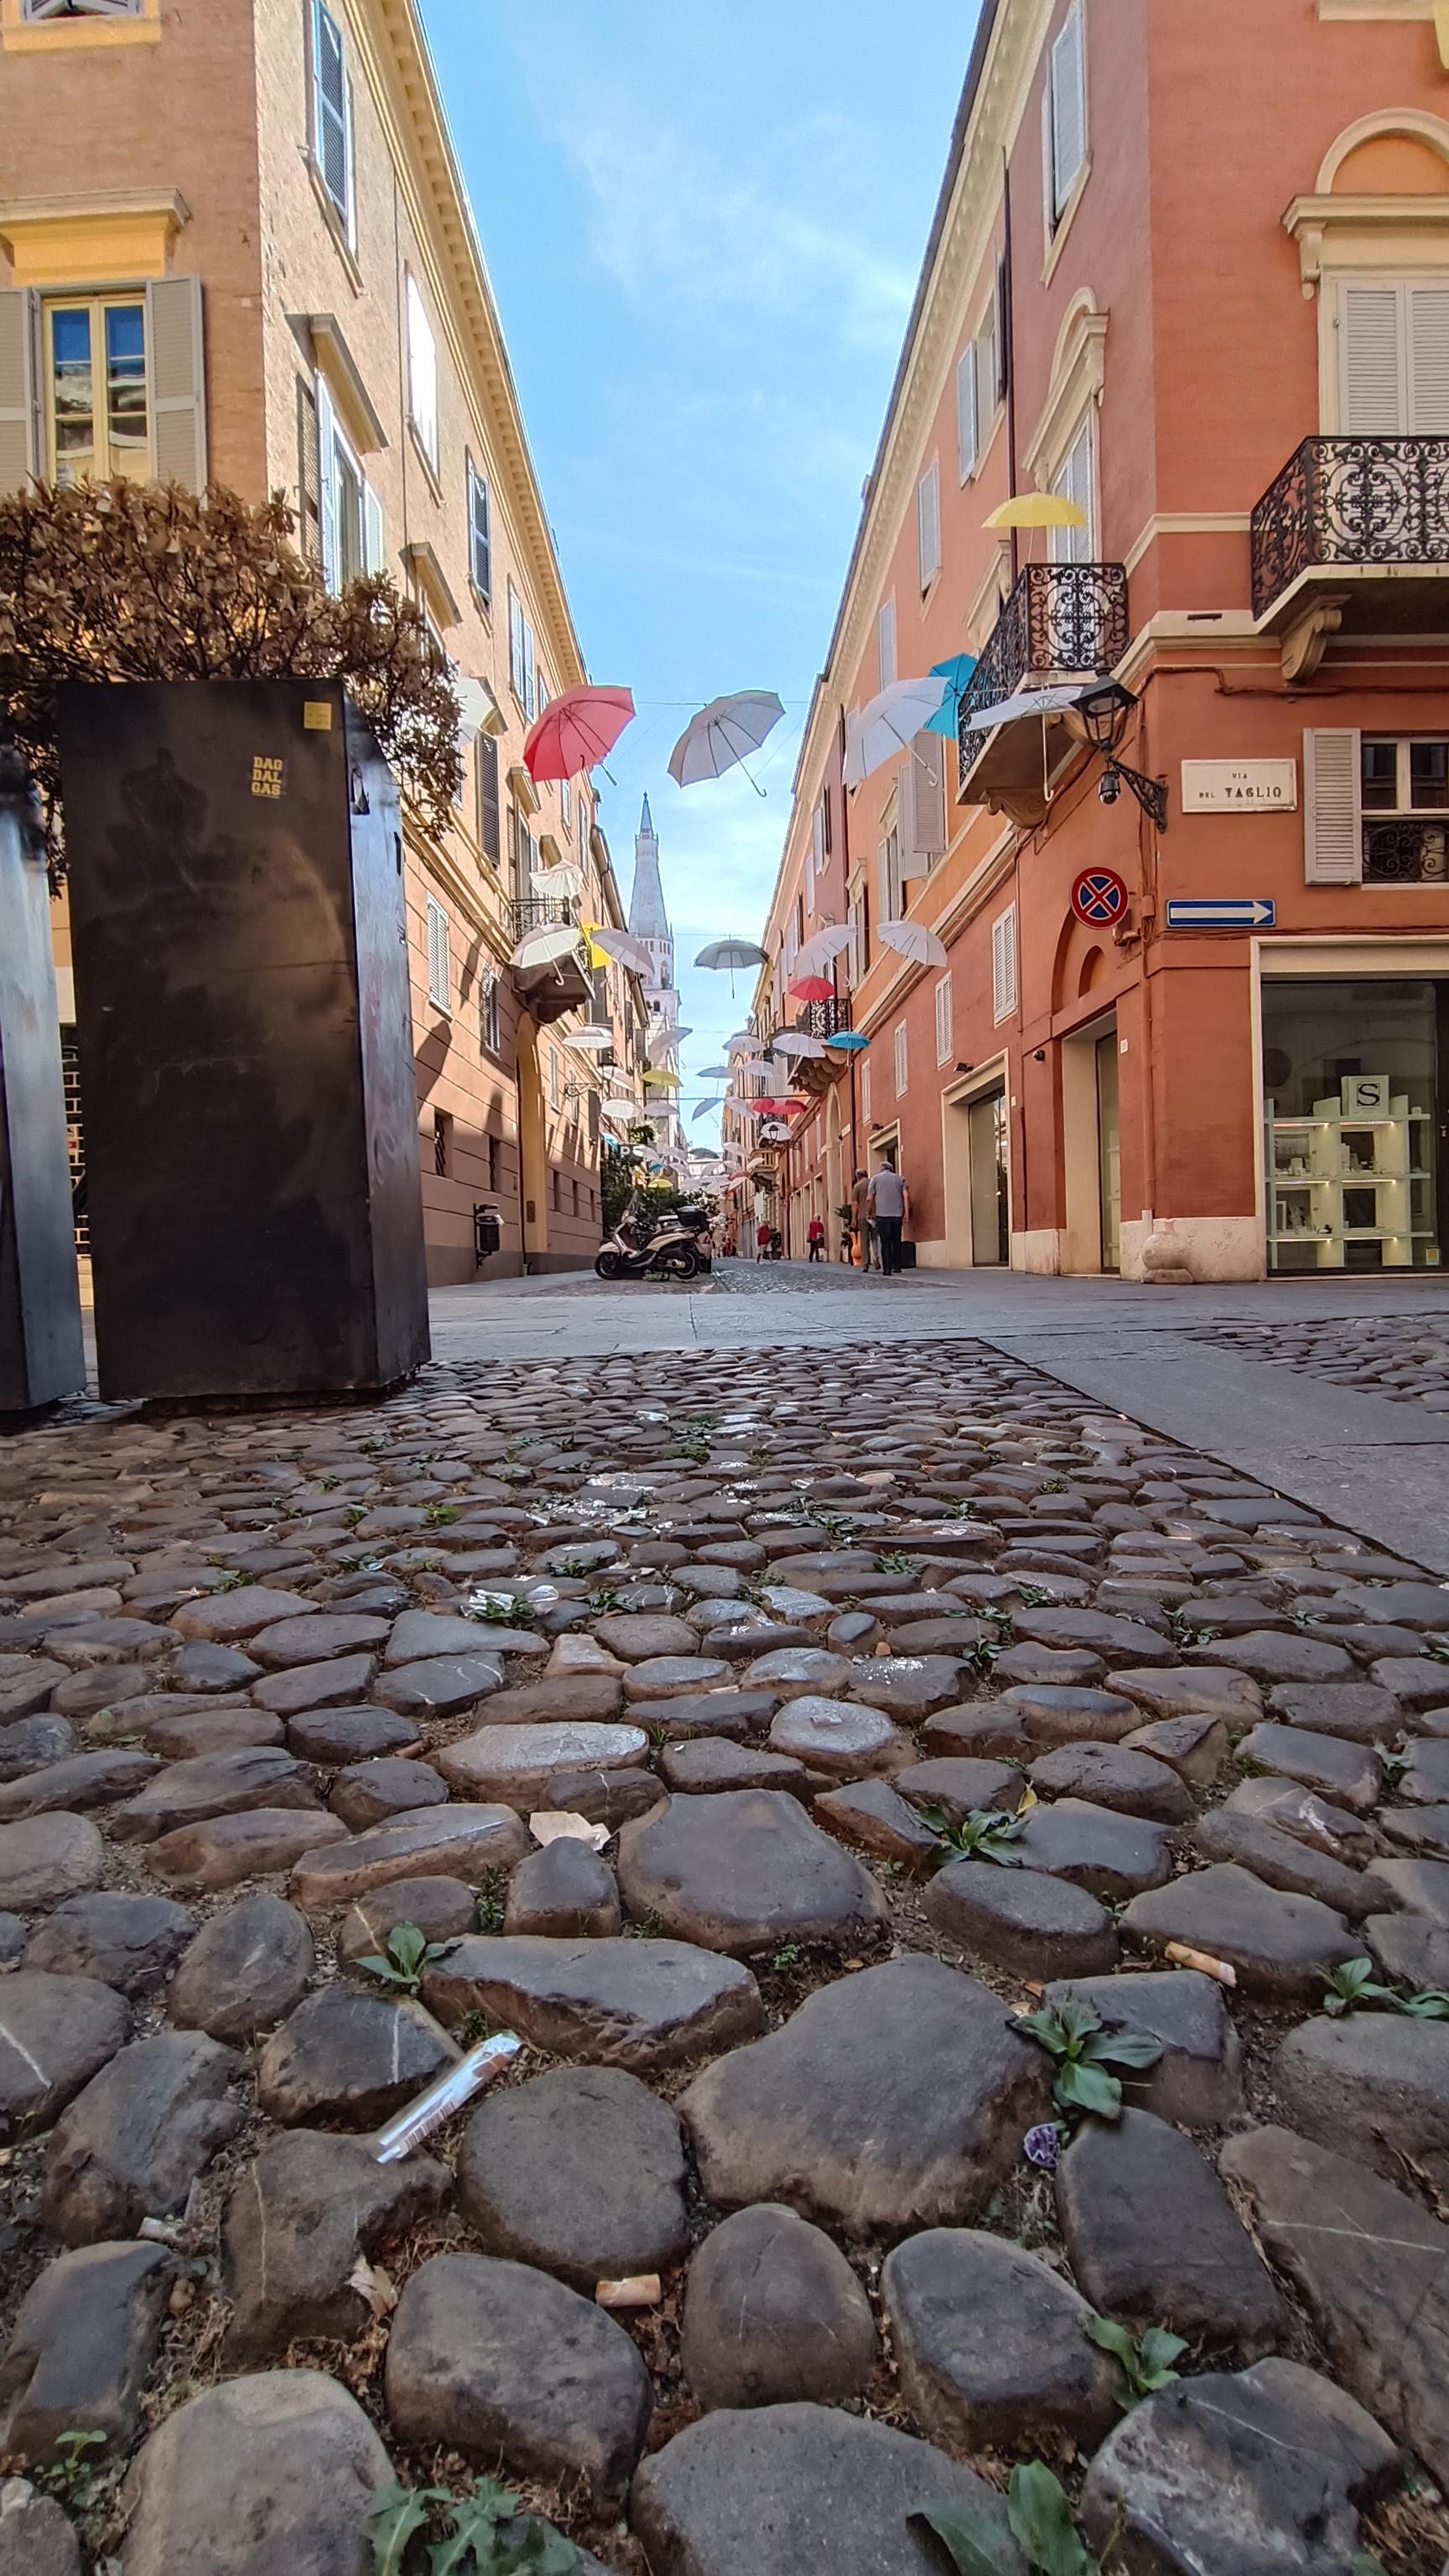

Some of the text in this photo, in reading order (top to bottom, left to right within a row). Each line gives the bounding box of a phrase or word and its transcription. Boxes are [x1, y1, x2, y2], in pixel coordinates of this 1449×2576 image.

[253, 756, 283, 771] DAG
[252, 768, 282, 784] DAL
[252, 782, 281, 796] GAS
[1224, 787, 1282, 798] TAGLIO
[1357, 1083, 1380, 1106] S
